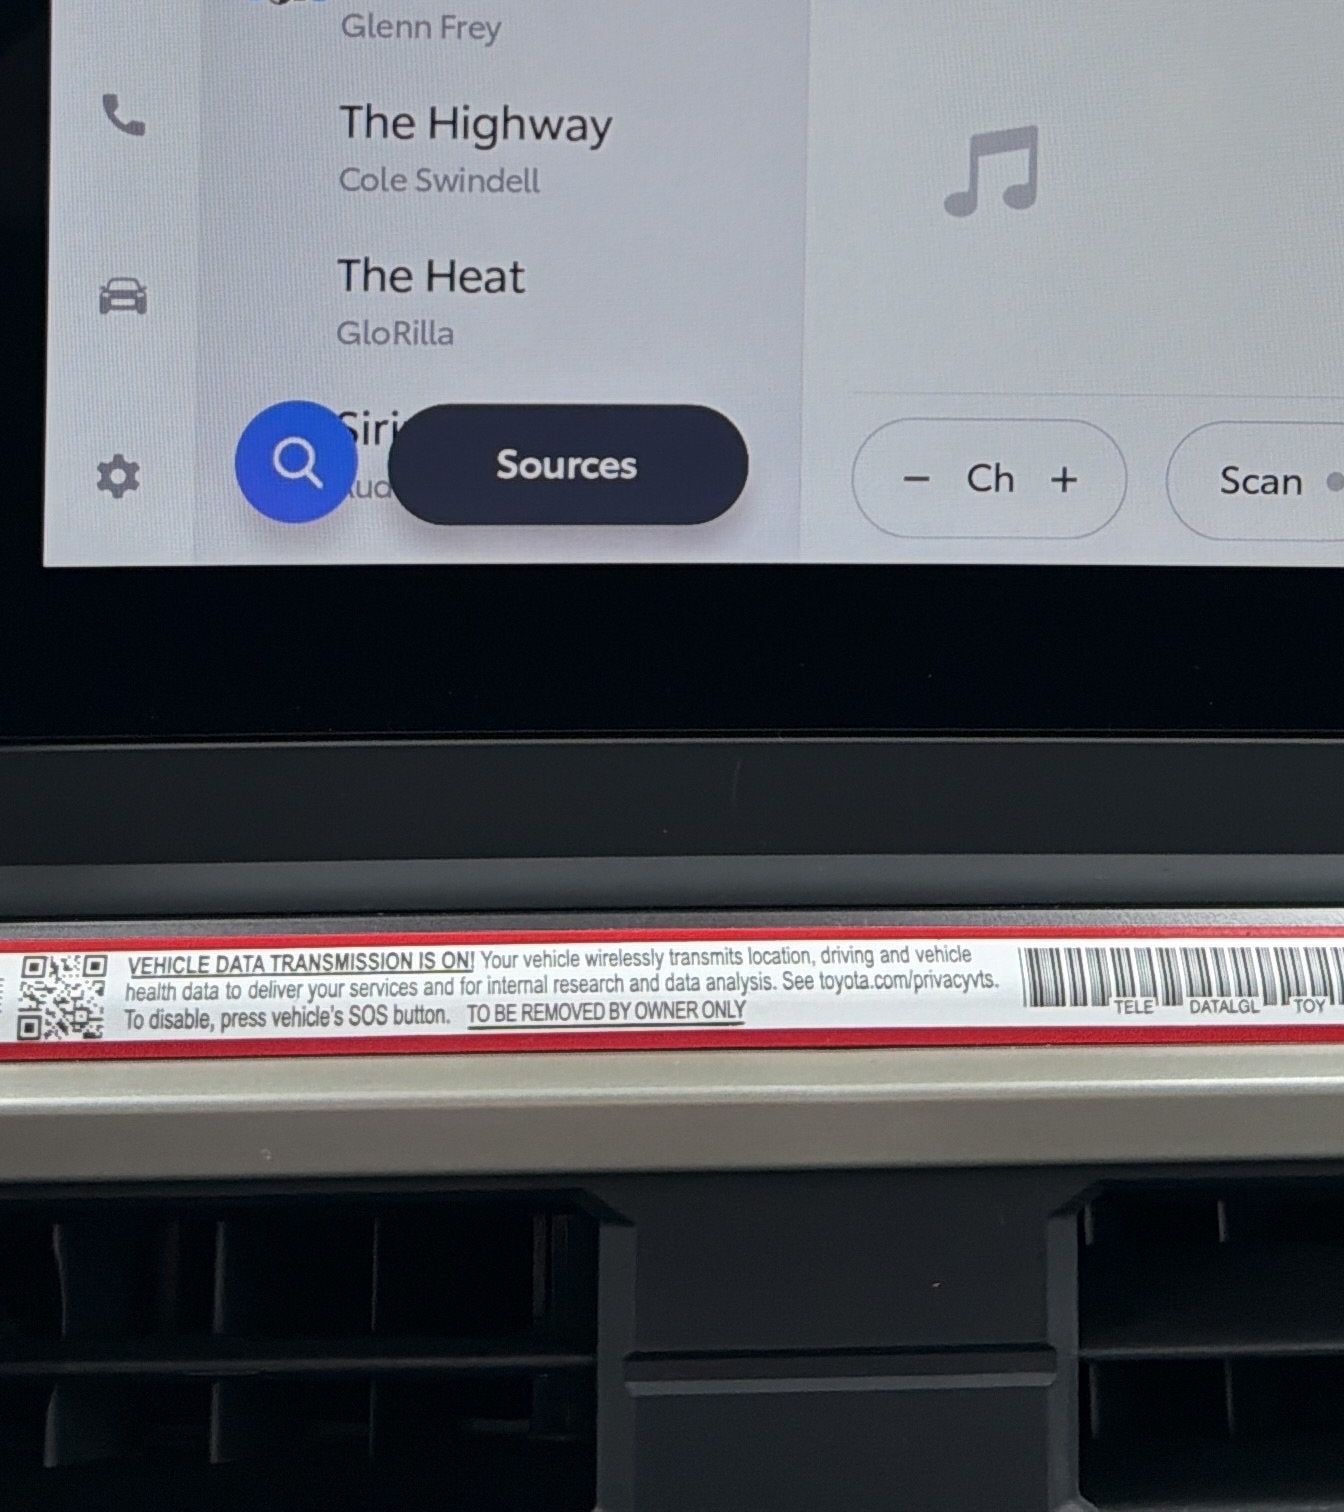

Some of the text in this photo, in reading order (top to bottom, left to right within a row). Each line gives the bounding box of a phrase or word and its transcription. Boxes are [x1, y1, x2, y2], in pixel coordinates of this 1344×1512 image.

[341, 13, 503, 48] Glenn Frey
[339, 103, 614, 152] The Highway
[339, 166, 541, 195] Cole Swindell
[337, 257, 526, 295] The Heat
[337, 320, 456, 348] GloRilla
[495, 448, 639, 482] Sources
[966, 461, 1016, 496] Ch
[1219, 464, 1304, 498] Scan
[128, 944, 972, 975] VEHICLE DATA TRANSMISSION IS ON! Your vehicle wirelessly transmits location, driving and vehicle
[125, 969, 1000, 1003] health data to deliver your services and for internal research and data analysis. See toyota.com/privacyvts.
[124, 999, 747, 1033] To disable, press vehicle's SOS button. TO BE REMOVED BY OWNER ONLY
[1114, 998, 1326, 1015] TELE DATALGL TOY
